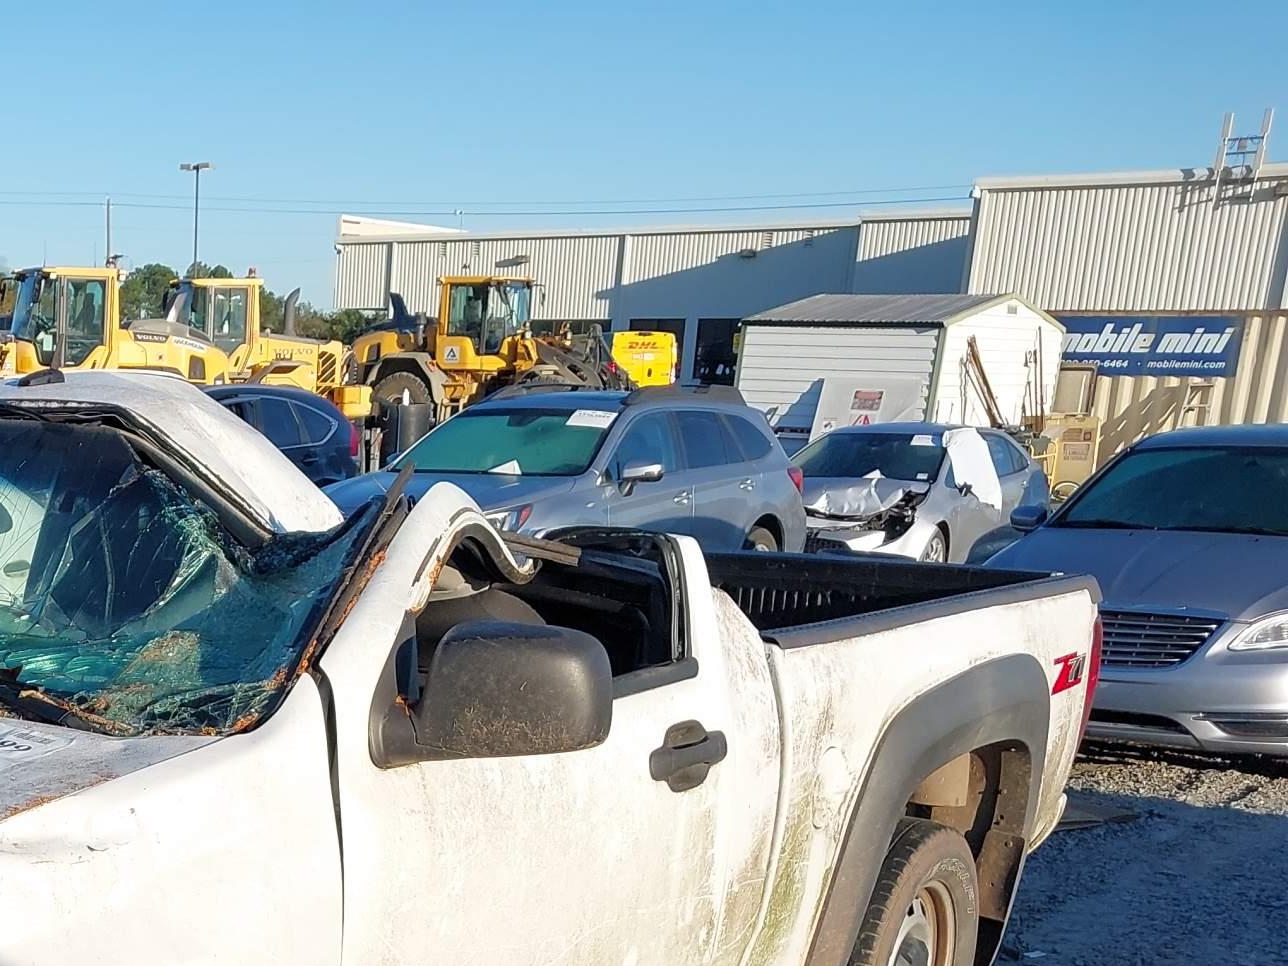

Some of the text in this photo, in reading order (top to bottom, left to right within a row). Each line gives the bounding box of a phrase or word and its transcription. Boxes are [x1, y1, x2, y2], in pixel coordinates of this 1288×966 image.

[628, 341, 657, 349] DHL
[1062, 323, 1236, 354] mobile mini
[1147, 359, 1226, 369] mobilemini.com
[1051, 651, 1087, 696] Z71
